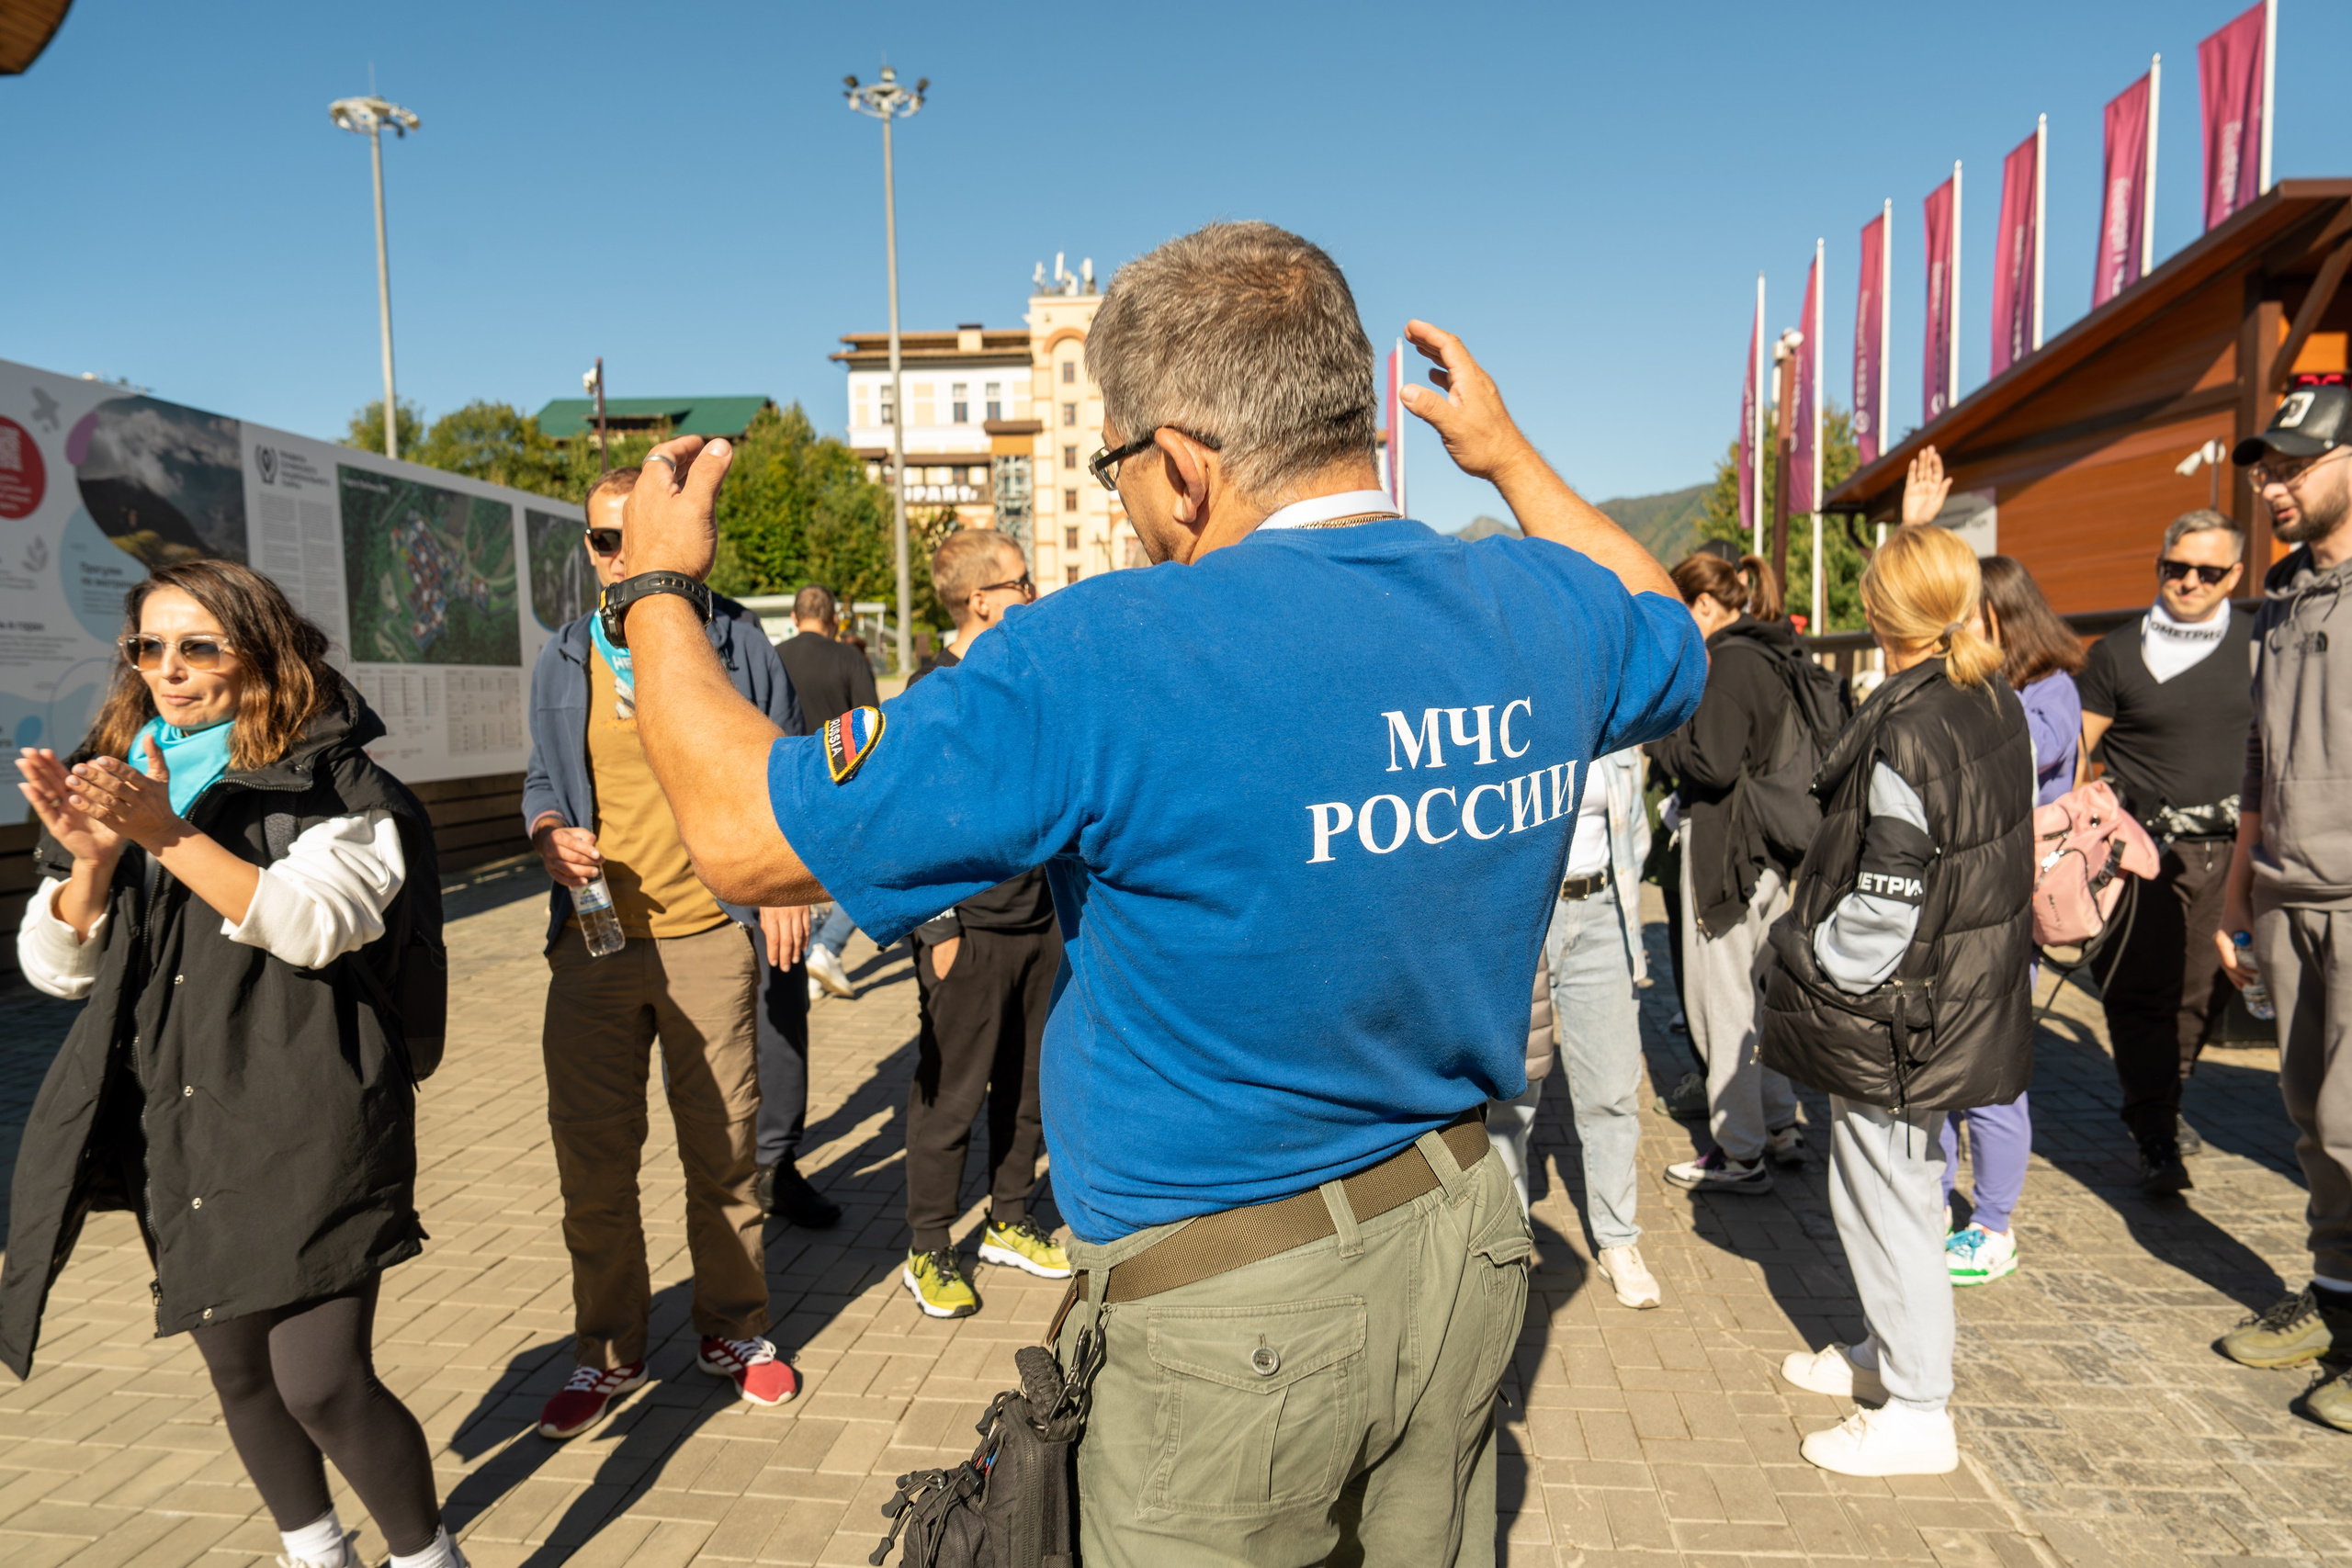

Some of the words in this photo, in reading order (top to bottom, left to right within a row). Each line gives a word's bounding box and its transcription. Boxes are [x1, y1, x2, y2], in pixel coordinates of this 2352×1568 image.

[829, 717, 843, 758] RUSSIA
[1381, 696, 1532, 773] МЧС
[1306, 760, 1578, 864] РОССИИ
